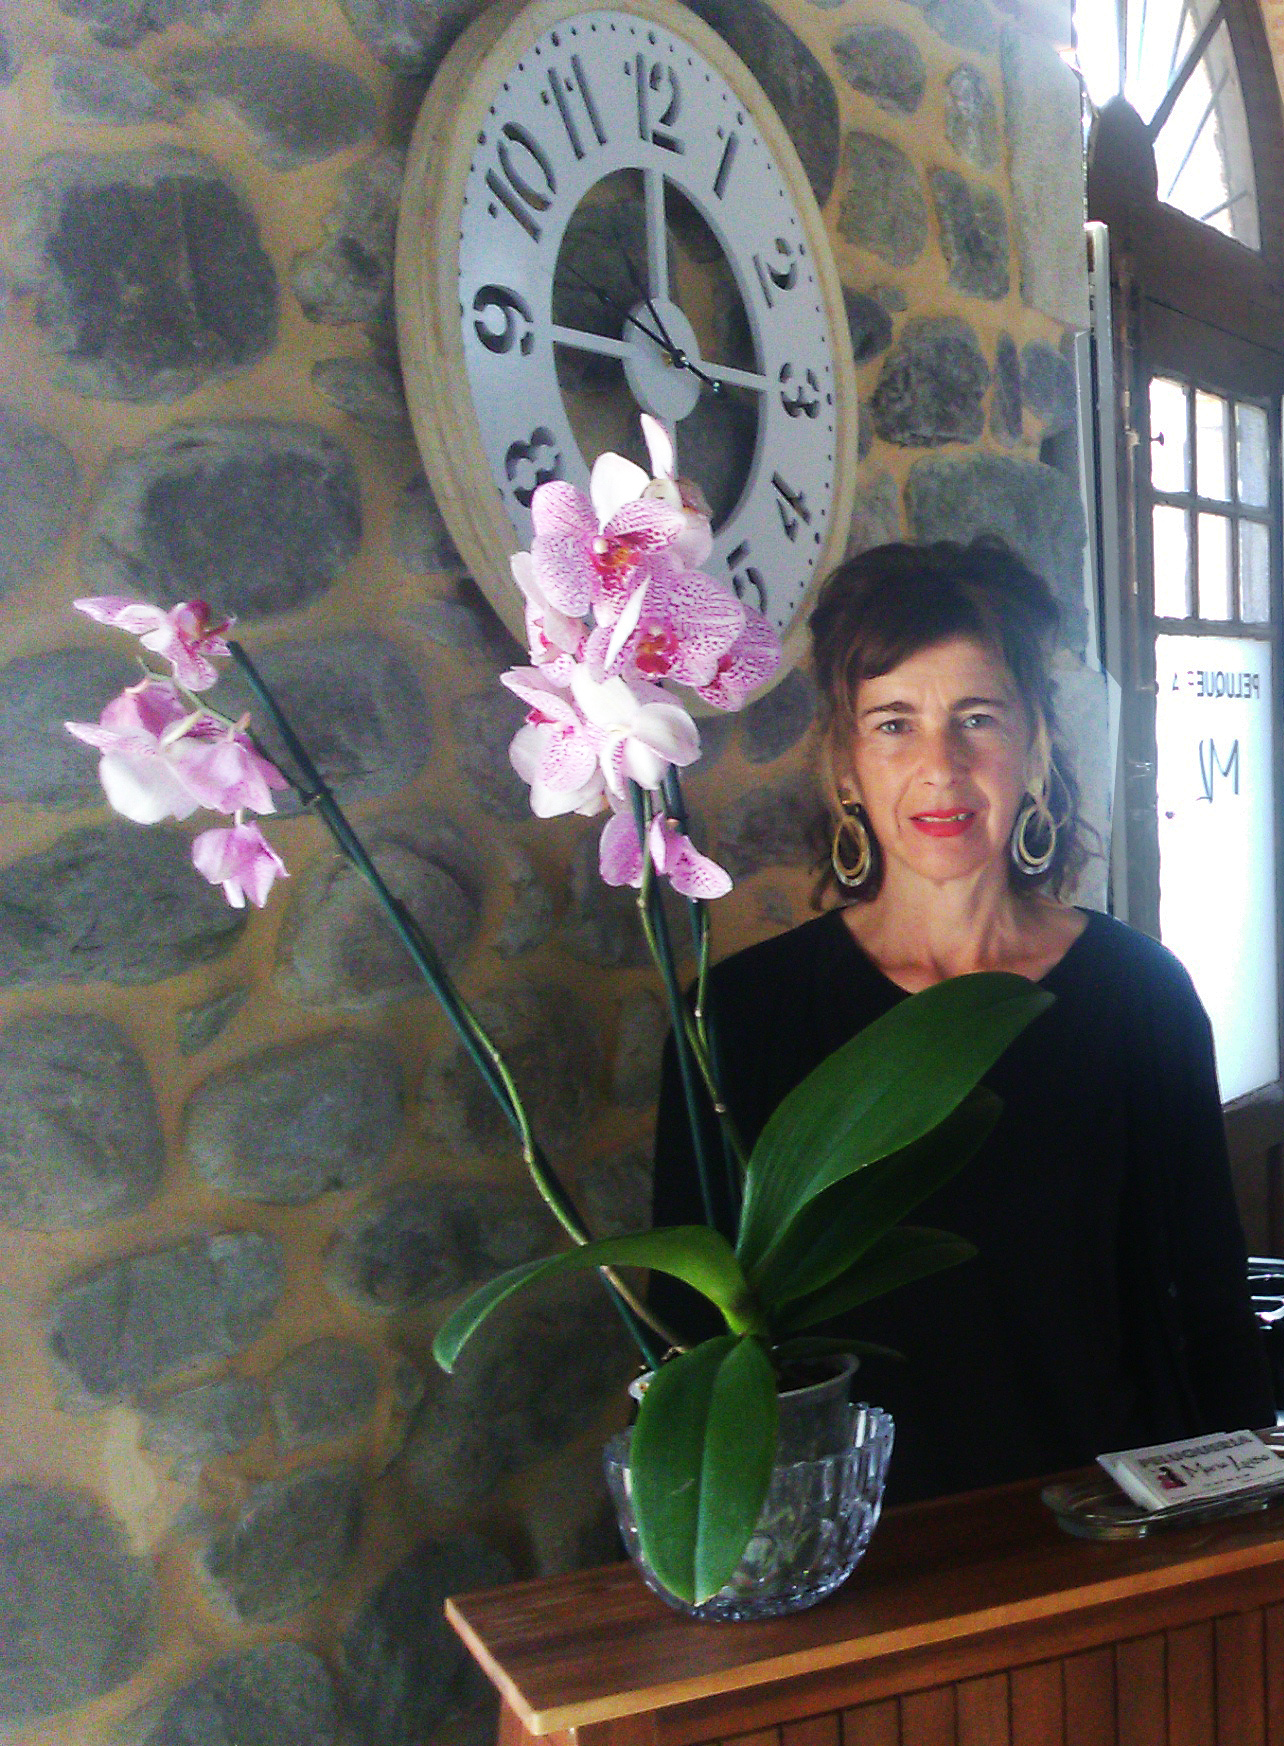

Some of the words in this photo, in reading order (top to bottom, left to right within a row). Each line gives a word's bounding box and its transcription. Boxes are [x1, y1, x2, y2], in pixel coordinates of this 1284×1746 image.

[540, 54, 606, 160] 11
[623, 52, 684, 156] 12
[484, 121, 556, 243] 10
[713, 126, 739, 200] 1
[752, 237, 799, 308] 2
[472, 283, 534, 356] 9
[778, 362, 821, 420] 3
[771, 470, 812, 542] 4
